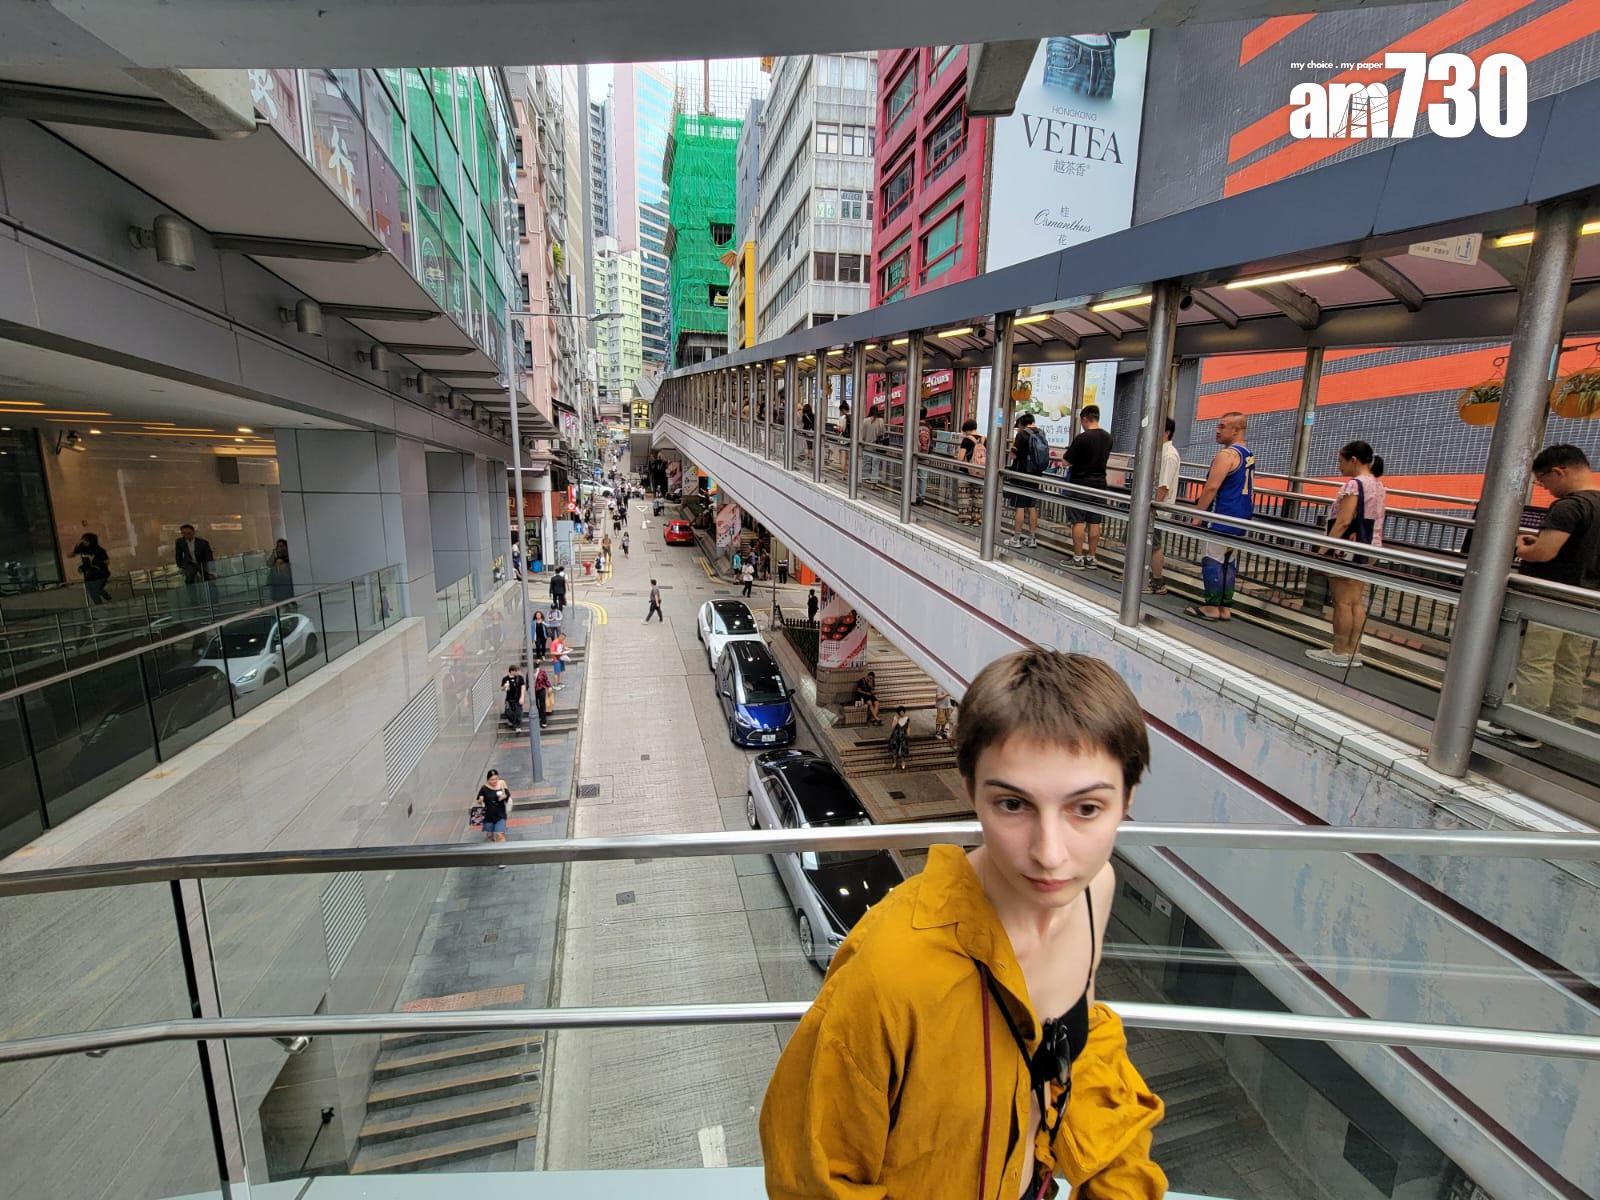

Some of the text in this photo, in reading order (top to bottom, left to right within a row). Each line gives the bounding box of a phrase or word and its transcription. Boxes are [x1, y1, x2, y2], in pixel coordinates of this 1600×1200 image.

[1051, 106, 1097, 121] HONGKONG
[1021, 113, 1124, 164] VETEA
[1053, 159, 1087, 176] 越茶香
[1060, 205, 1070, 217] 桂
[1033, 209, 1092, 232] Osmanthus
[1057, 234, 1067, 245] 花
